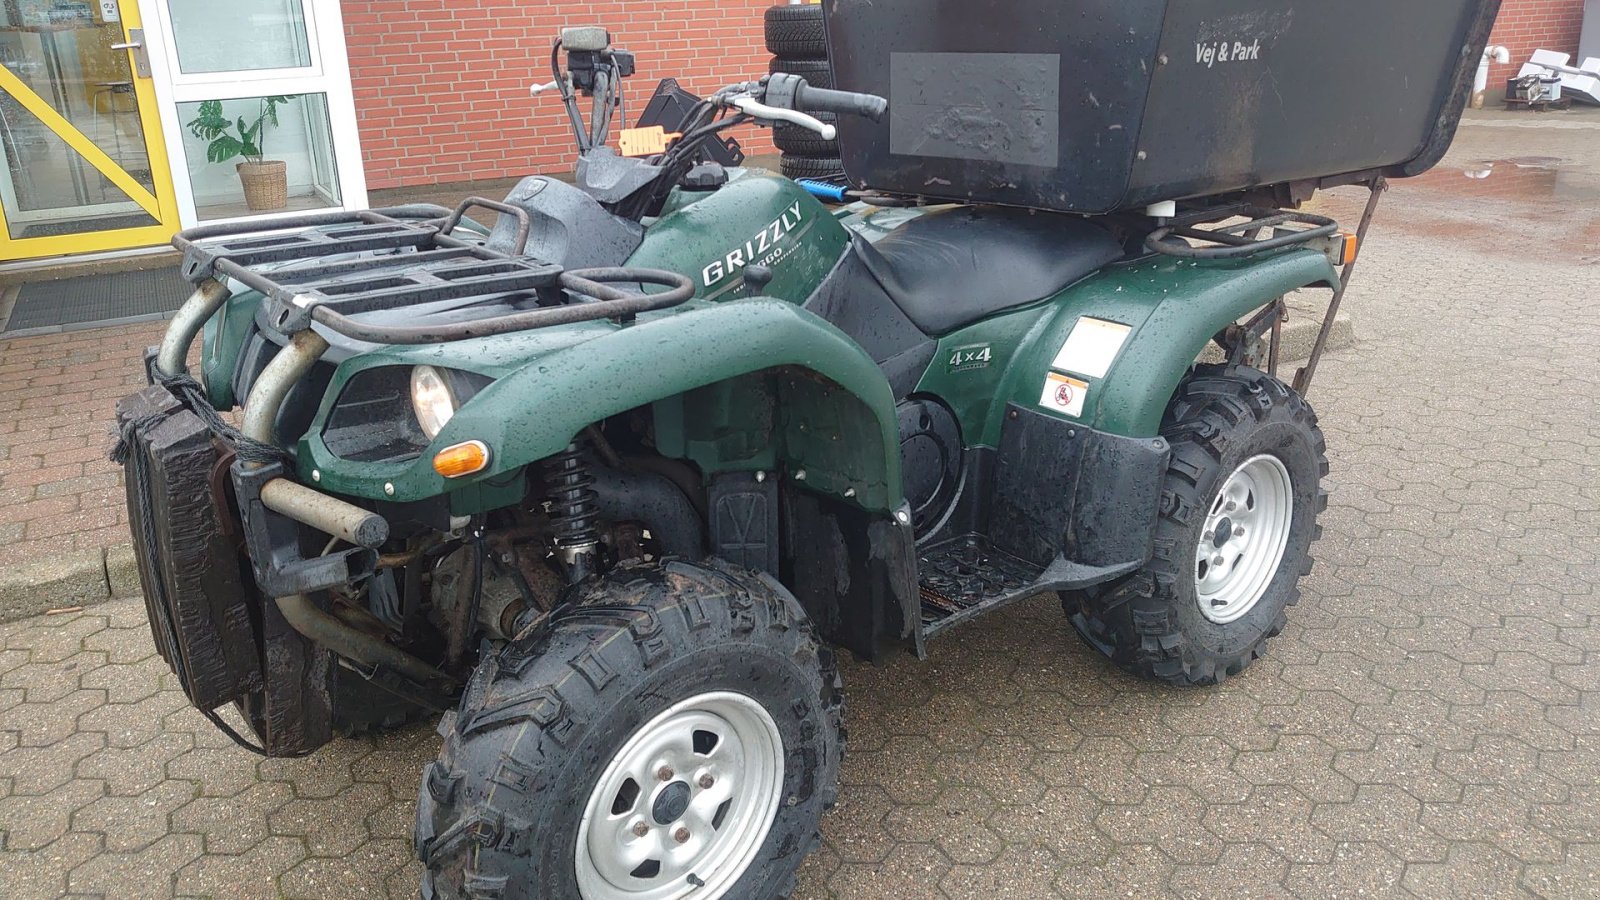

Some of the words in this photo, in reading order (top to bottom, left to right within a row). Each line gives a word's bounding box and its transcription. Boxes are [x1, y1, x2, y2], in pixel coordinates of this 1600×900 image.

[1196, 41, 1217, 68] Vej
[1218, 41, 1228, 62] &
[1231, 38, 1260, 61] Park
[702, 201, 802, 287] GRIZZLY
